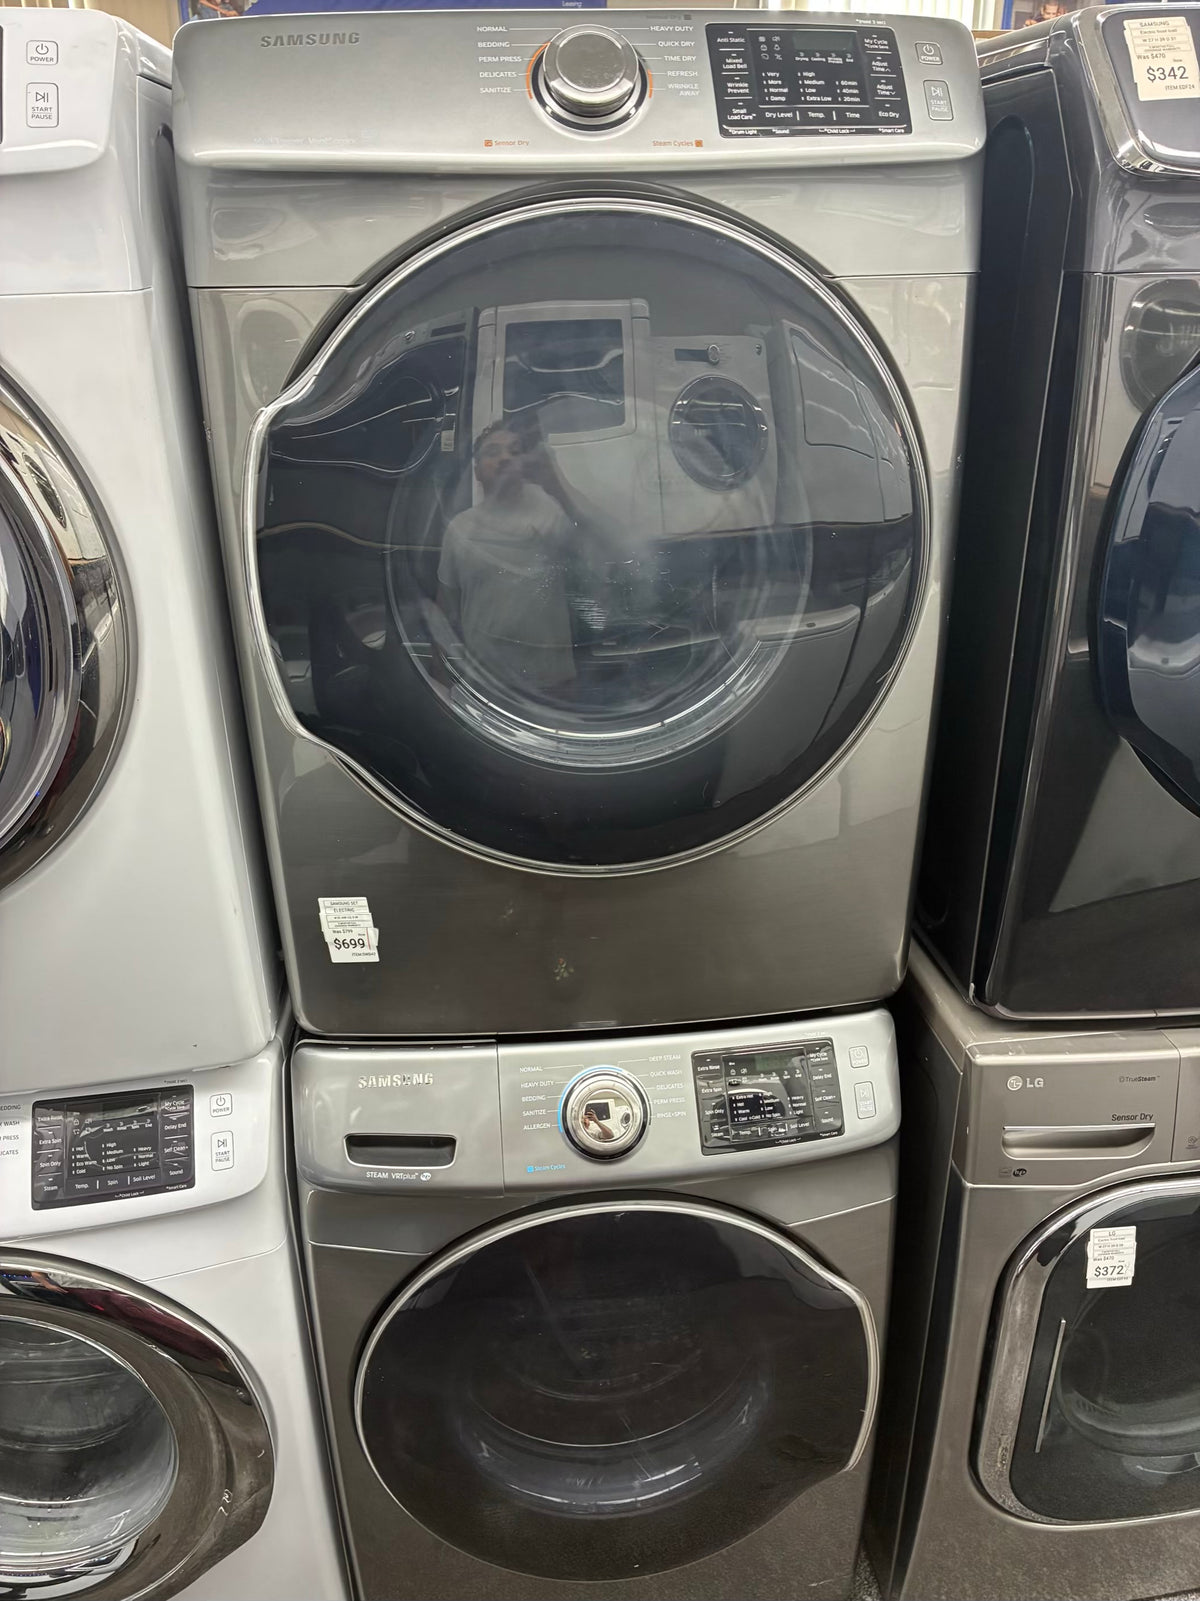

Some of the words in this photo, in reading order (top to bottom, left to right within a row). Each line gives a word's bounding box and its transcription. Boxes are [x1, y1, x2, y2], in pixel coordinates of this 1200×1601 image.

[260, 32, 360, 48] SAMSUNG
[1147, 65, 1189, 83] $342
[808, 111, 826, 119] Temp.
[333, 938, 366, 951] $699
[1026, 1077, 1044, 1088] LG
[213, 1106, 230, 1114] POWER
[522, 1109, 547, 1117] SANITIZE
[1111, 1113, 1139, 1122] Sensor
[1139, 1112, 1154, 1122] Dry
[164, 1123, 177, 1131] Delay
[523, 1122, 551, 1131] ALLERGEN
[164, 1146, 173, 1154] Self
[215, 1150, 230, 1158] START
[40, 1161, 50, 1169] Spin
[51, 1160, 62, 1168] Only
[169, 1168, 184, 1176] Sound
[366, 1171, 389, 1179] STEAM
[1094, 1264, 1124, 1278] $372
